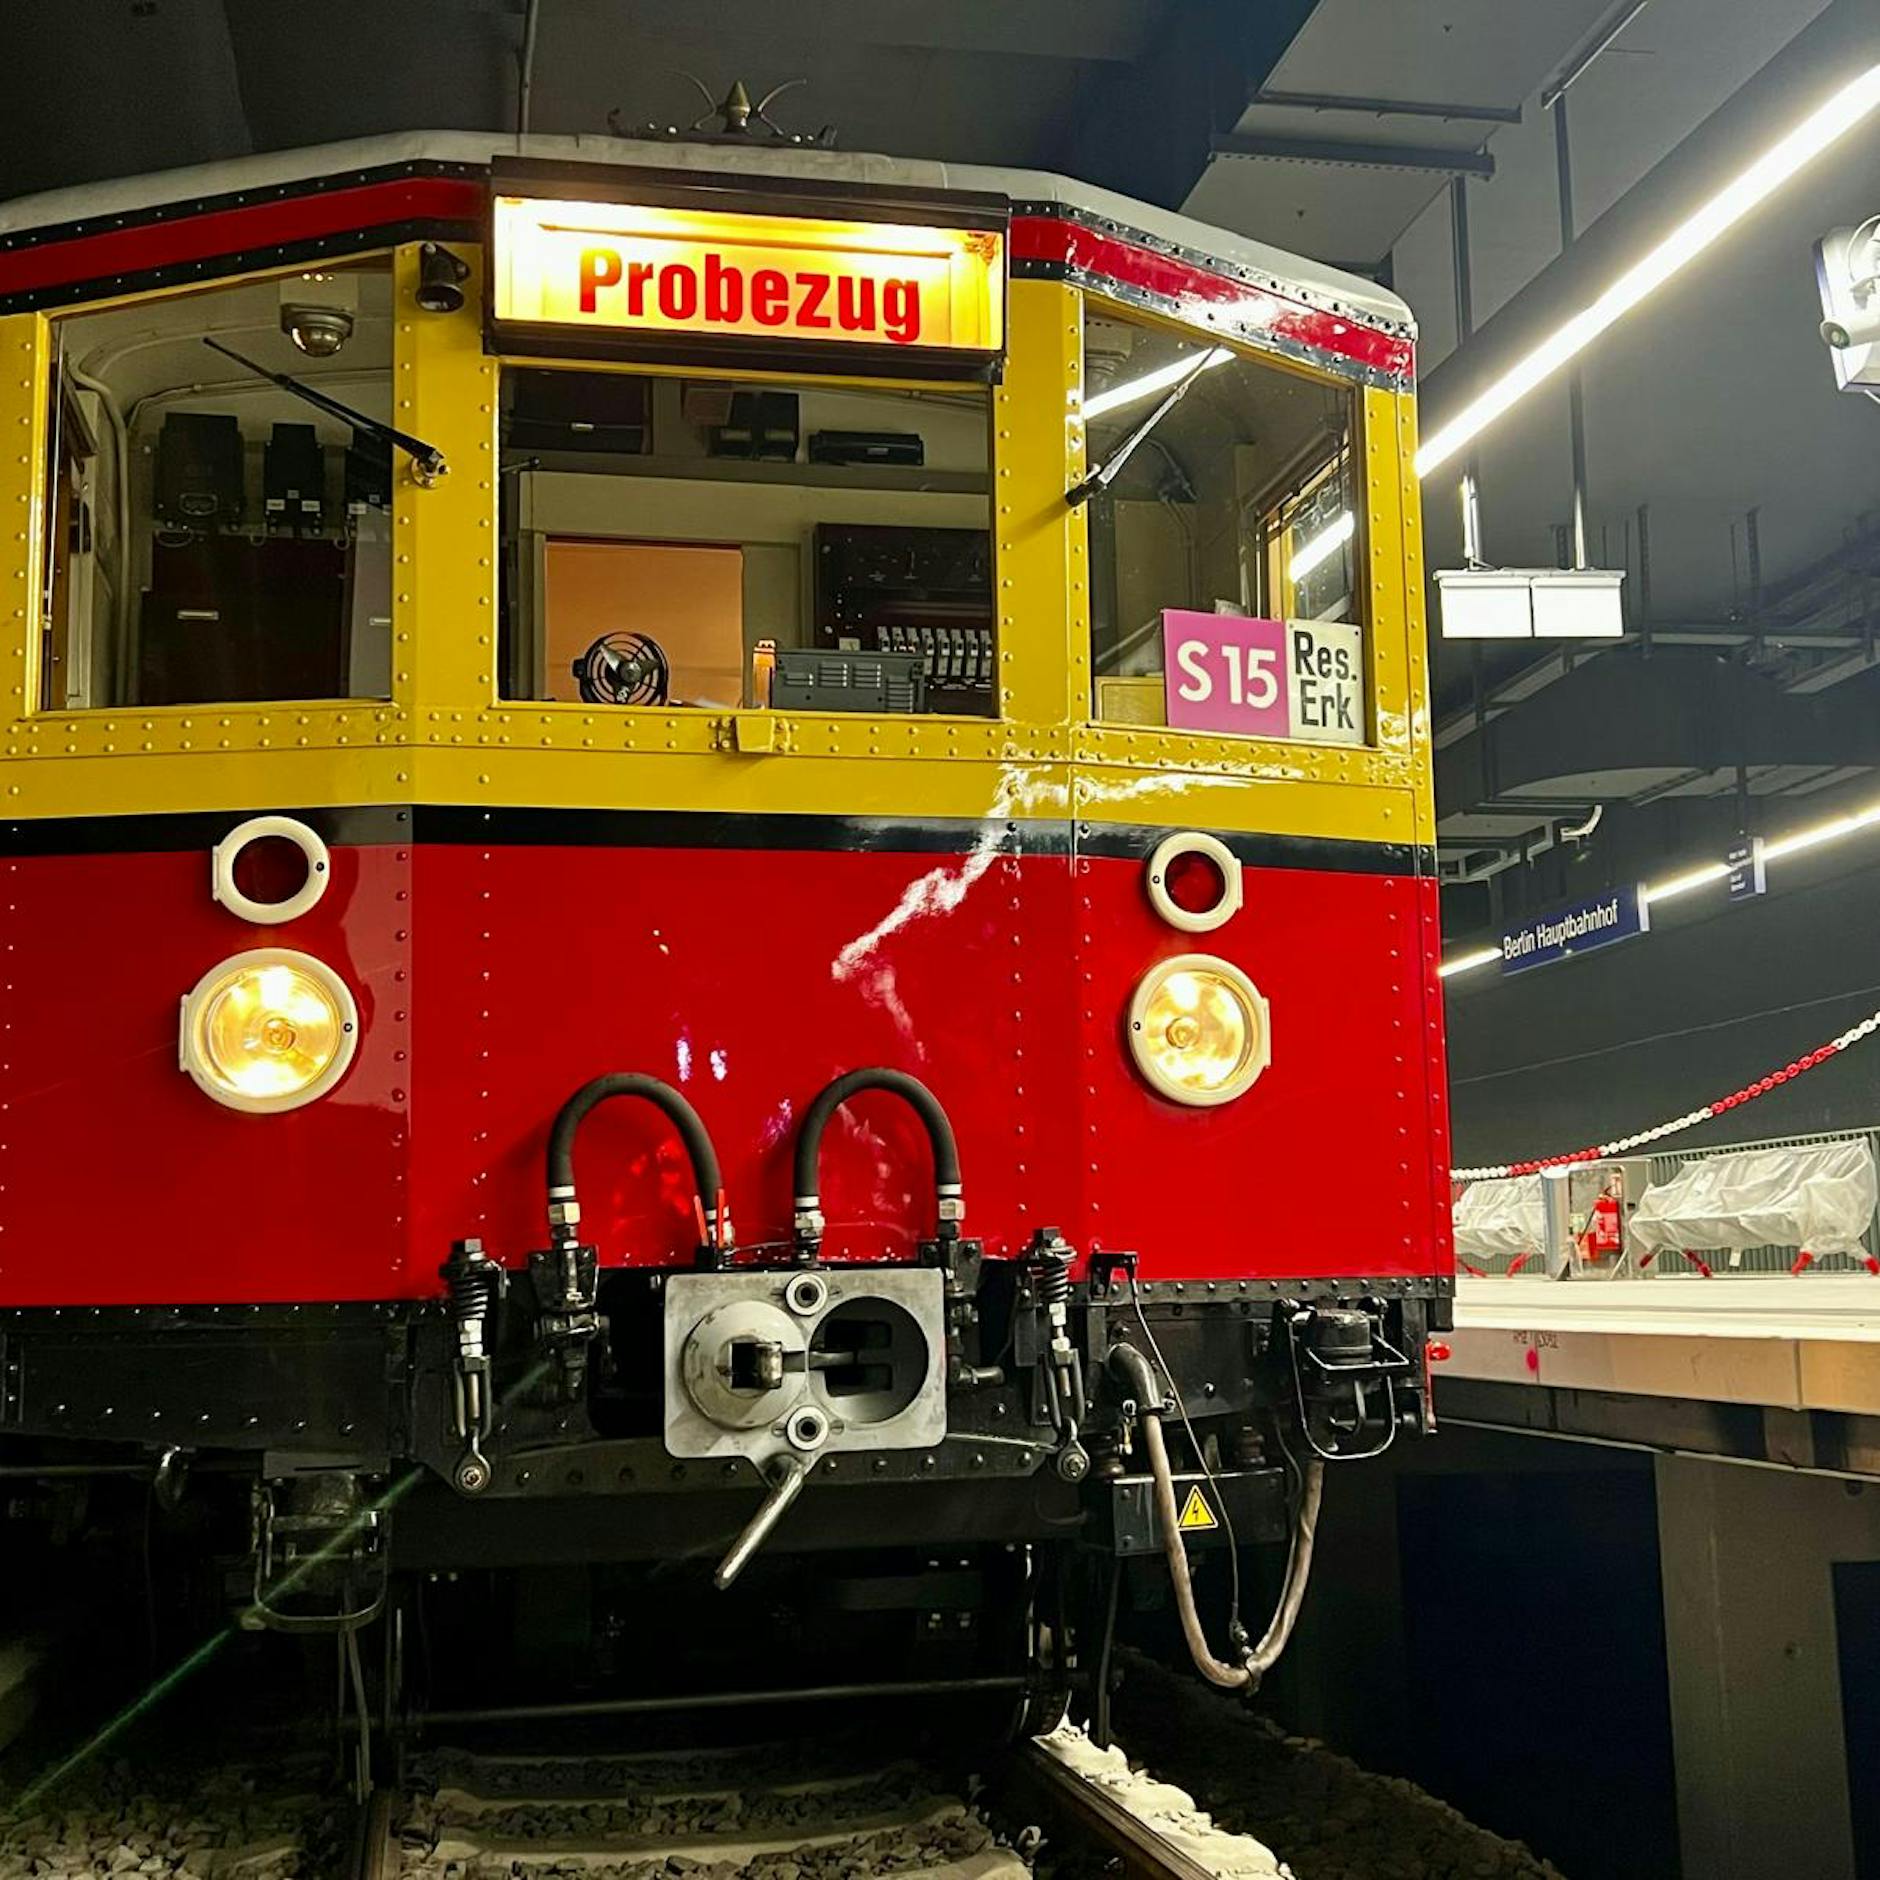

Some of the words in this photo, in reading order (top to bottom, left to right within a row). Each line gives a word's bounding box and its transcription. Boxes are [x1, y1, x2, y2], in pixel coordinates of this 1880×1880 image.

[579, 248, 921, 343] Probezug
[1294, 630, 1357, 681] Res.
[1300, 679, 1355, 730] Erk
[1502, 929, 1537, 960] Berlin
[1536, 898, 1618, 949] Hauptbahnhof
